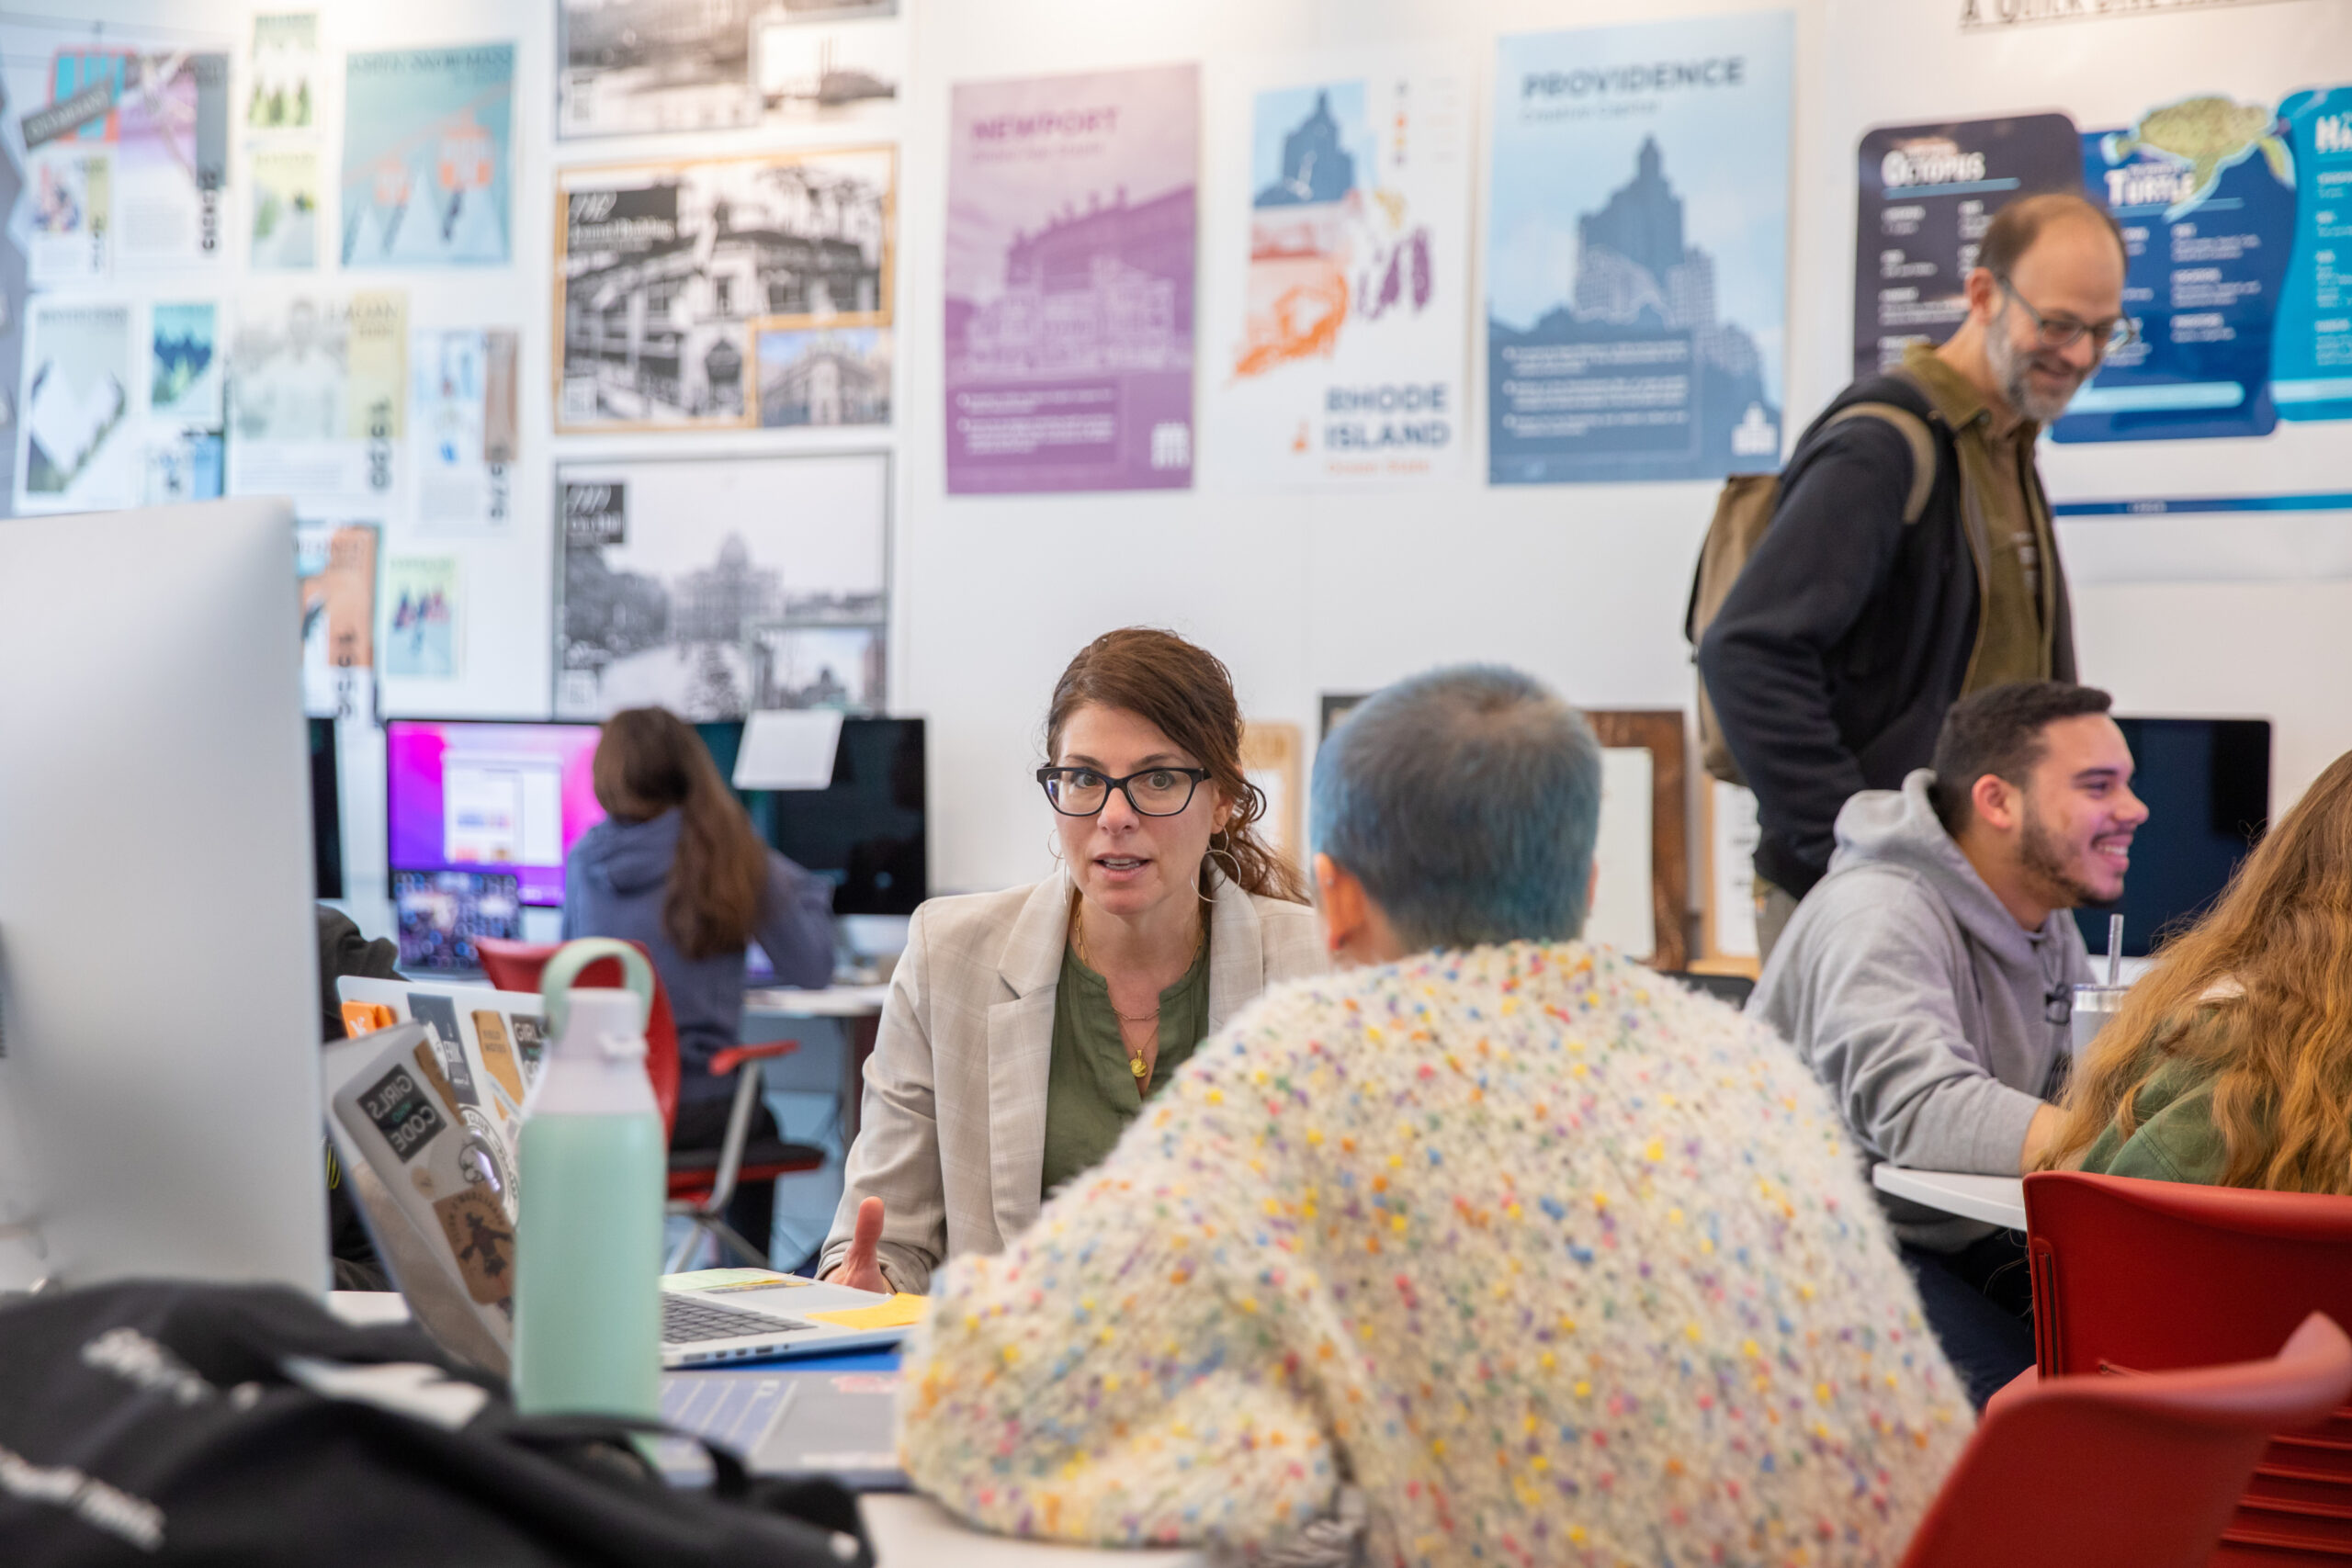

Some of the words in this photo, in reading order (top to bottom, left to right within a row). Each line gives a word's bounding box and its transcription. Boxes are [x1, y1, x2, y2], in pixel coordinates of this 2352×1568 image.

[1521, 57, 1747, 98] PROVIDENCE
[971, 106, 1121, 141] NEWPORT
[1882, 151, 1986, 187] OCTOPUS
[1326, 384, 1448, 412] RHODE
[1325, 421, 1451, 450] ISLAND
